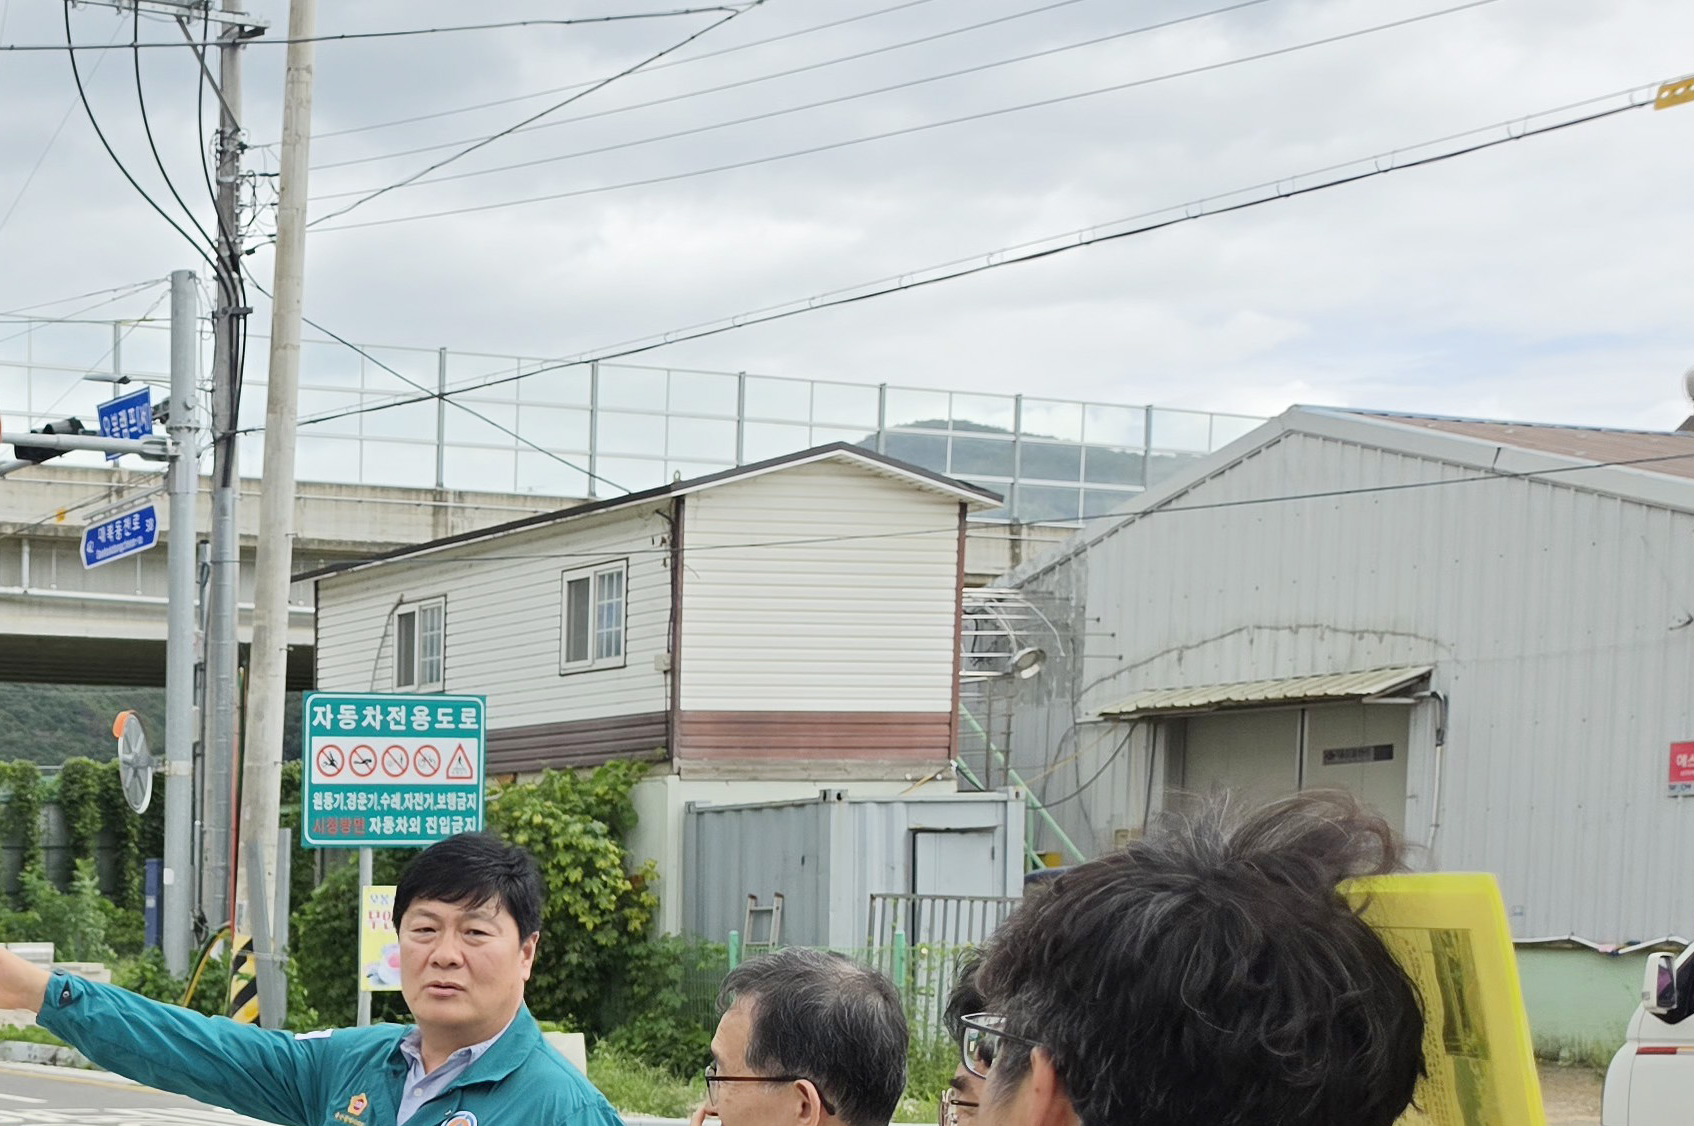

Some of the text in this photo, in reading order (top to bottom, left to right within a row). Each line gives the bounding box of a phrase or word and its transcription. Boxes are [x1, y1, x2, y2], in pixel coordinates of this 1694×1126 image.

[312, 704, 479, 731] 자동차전용도로
[369, 815, 421, 835] 자동차외
[425, 815, 477, 835] 진입금지
